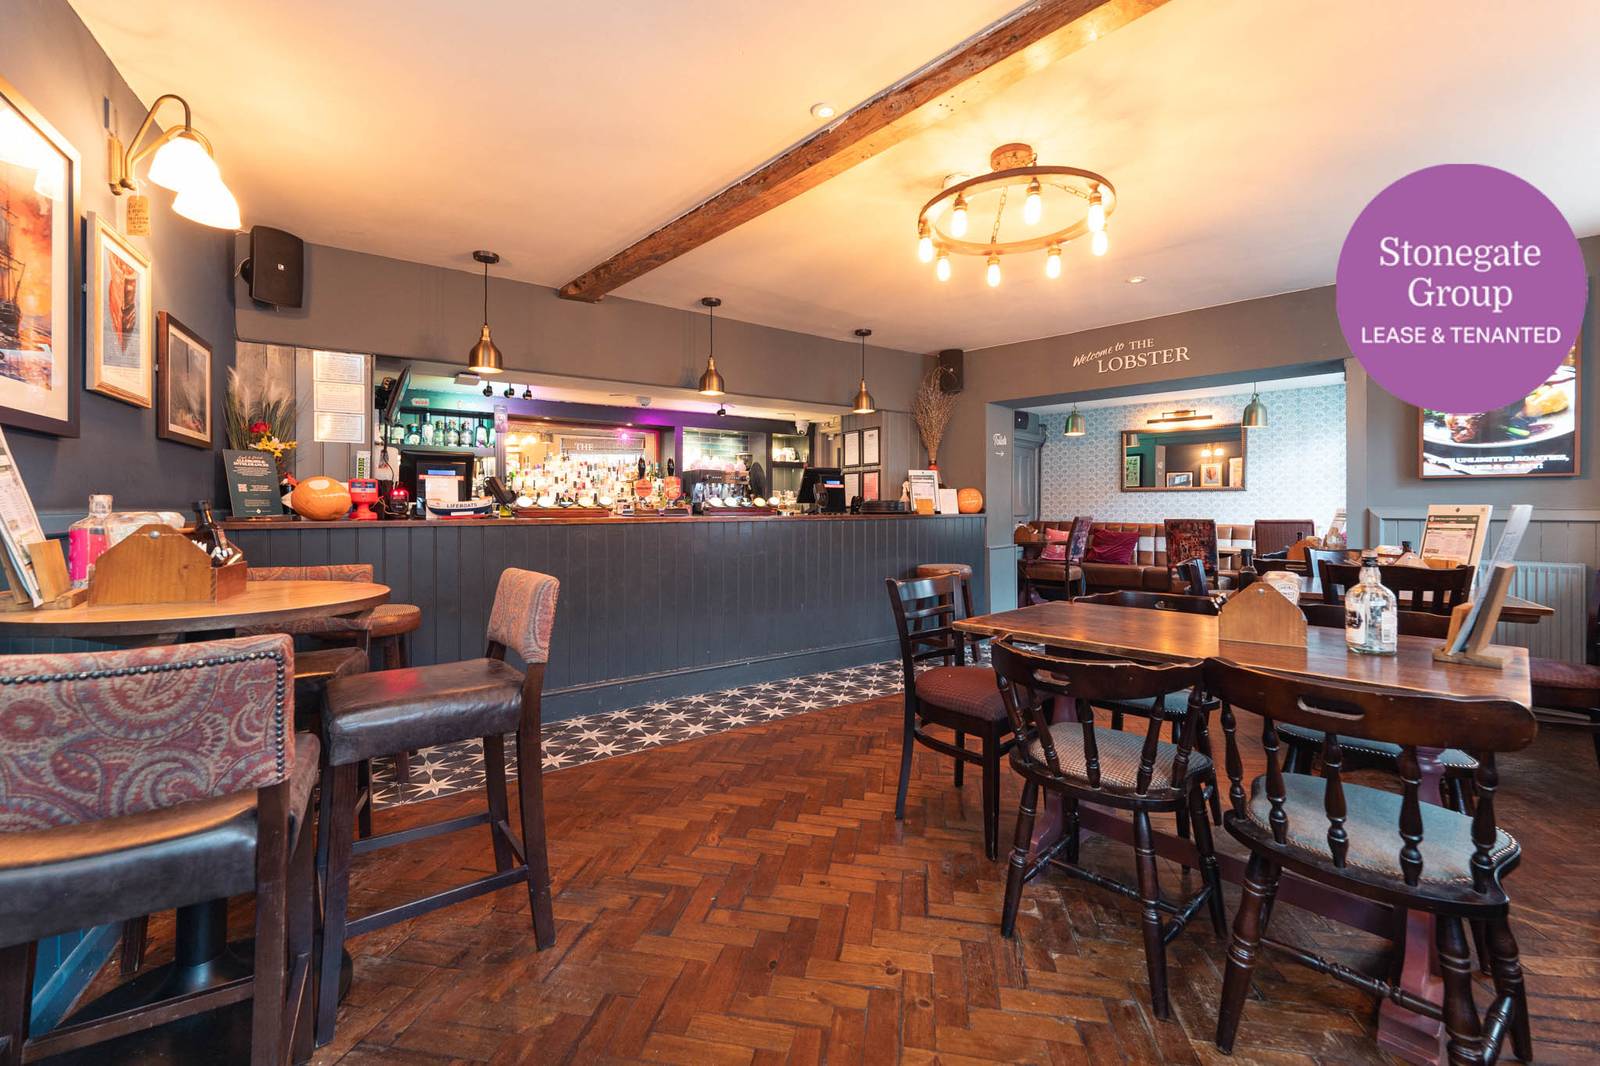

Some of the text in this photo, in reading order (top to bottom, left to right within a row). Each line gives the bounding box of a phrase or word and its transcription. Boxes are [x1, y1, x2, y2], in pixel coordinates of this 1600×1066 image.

[1073, 338, 1155, 368] Welcome to THE
[1097, 346, 1190, 373] LOBSTER
